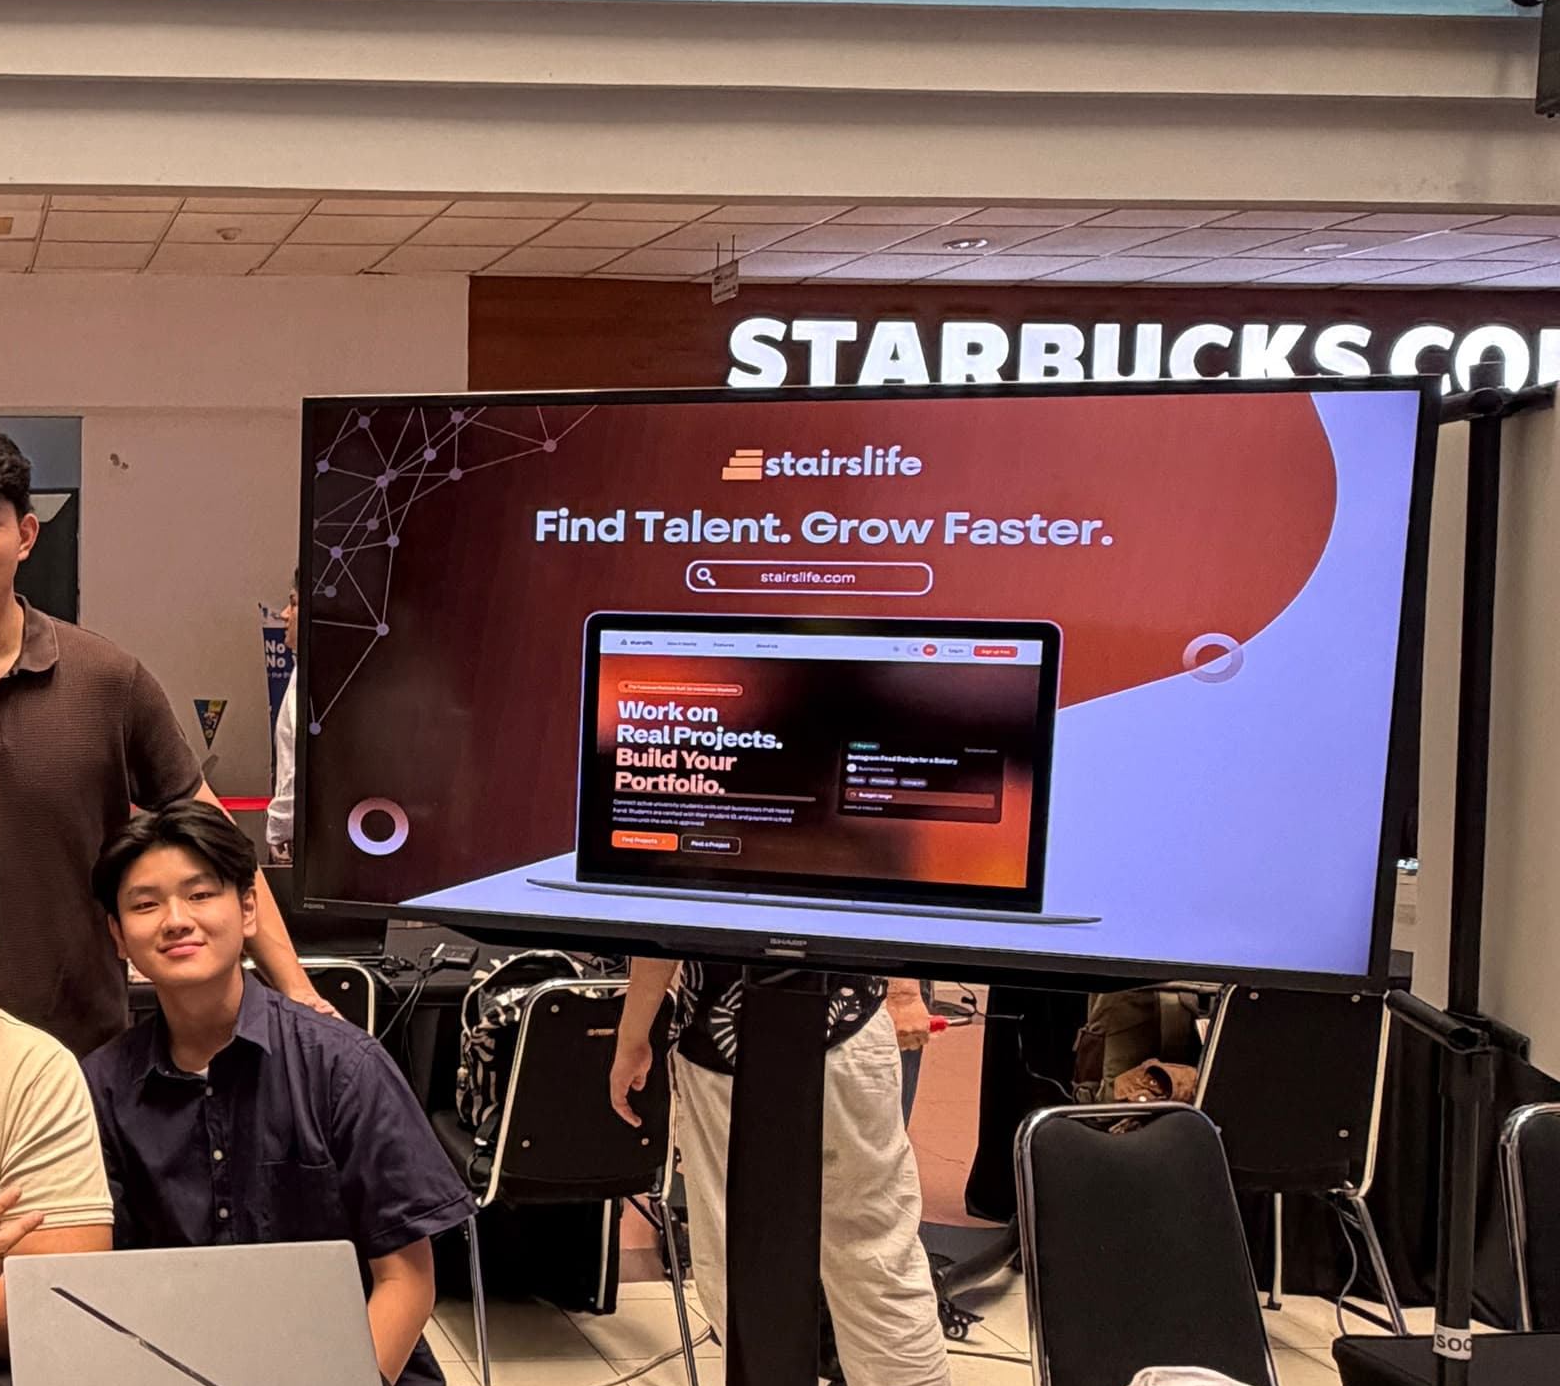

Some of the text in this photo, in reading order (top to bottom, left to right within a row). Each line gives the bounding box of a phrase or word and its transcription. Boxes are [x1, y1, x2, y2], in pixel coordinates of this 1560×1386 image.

[726, 317, 1560, 396] STARBUCKS CO
[764, 445, 923, 479] stairslife
[535, 507, 1114, 547] Find Talent. Grow Faster.
[760, 569, 856, 586] stairslife.com
[265, 640, 286, 654] No
[266, 654, 286, 669] No
[618, 701, 718, 723] Work on
[617, 724, 783, 751] Real Projects.
[616, 747, 738, 771] Build Your
[615, 771, 726, 795] Portfolio.
